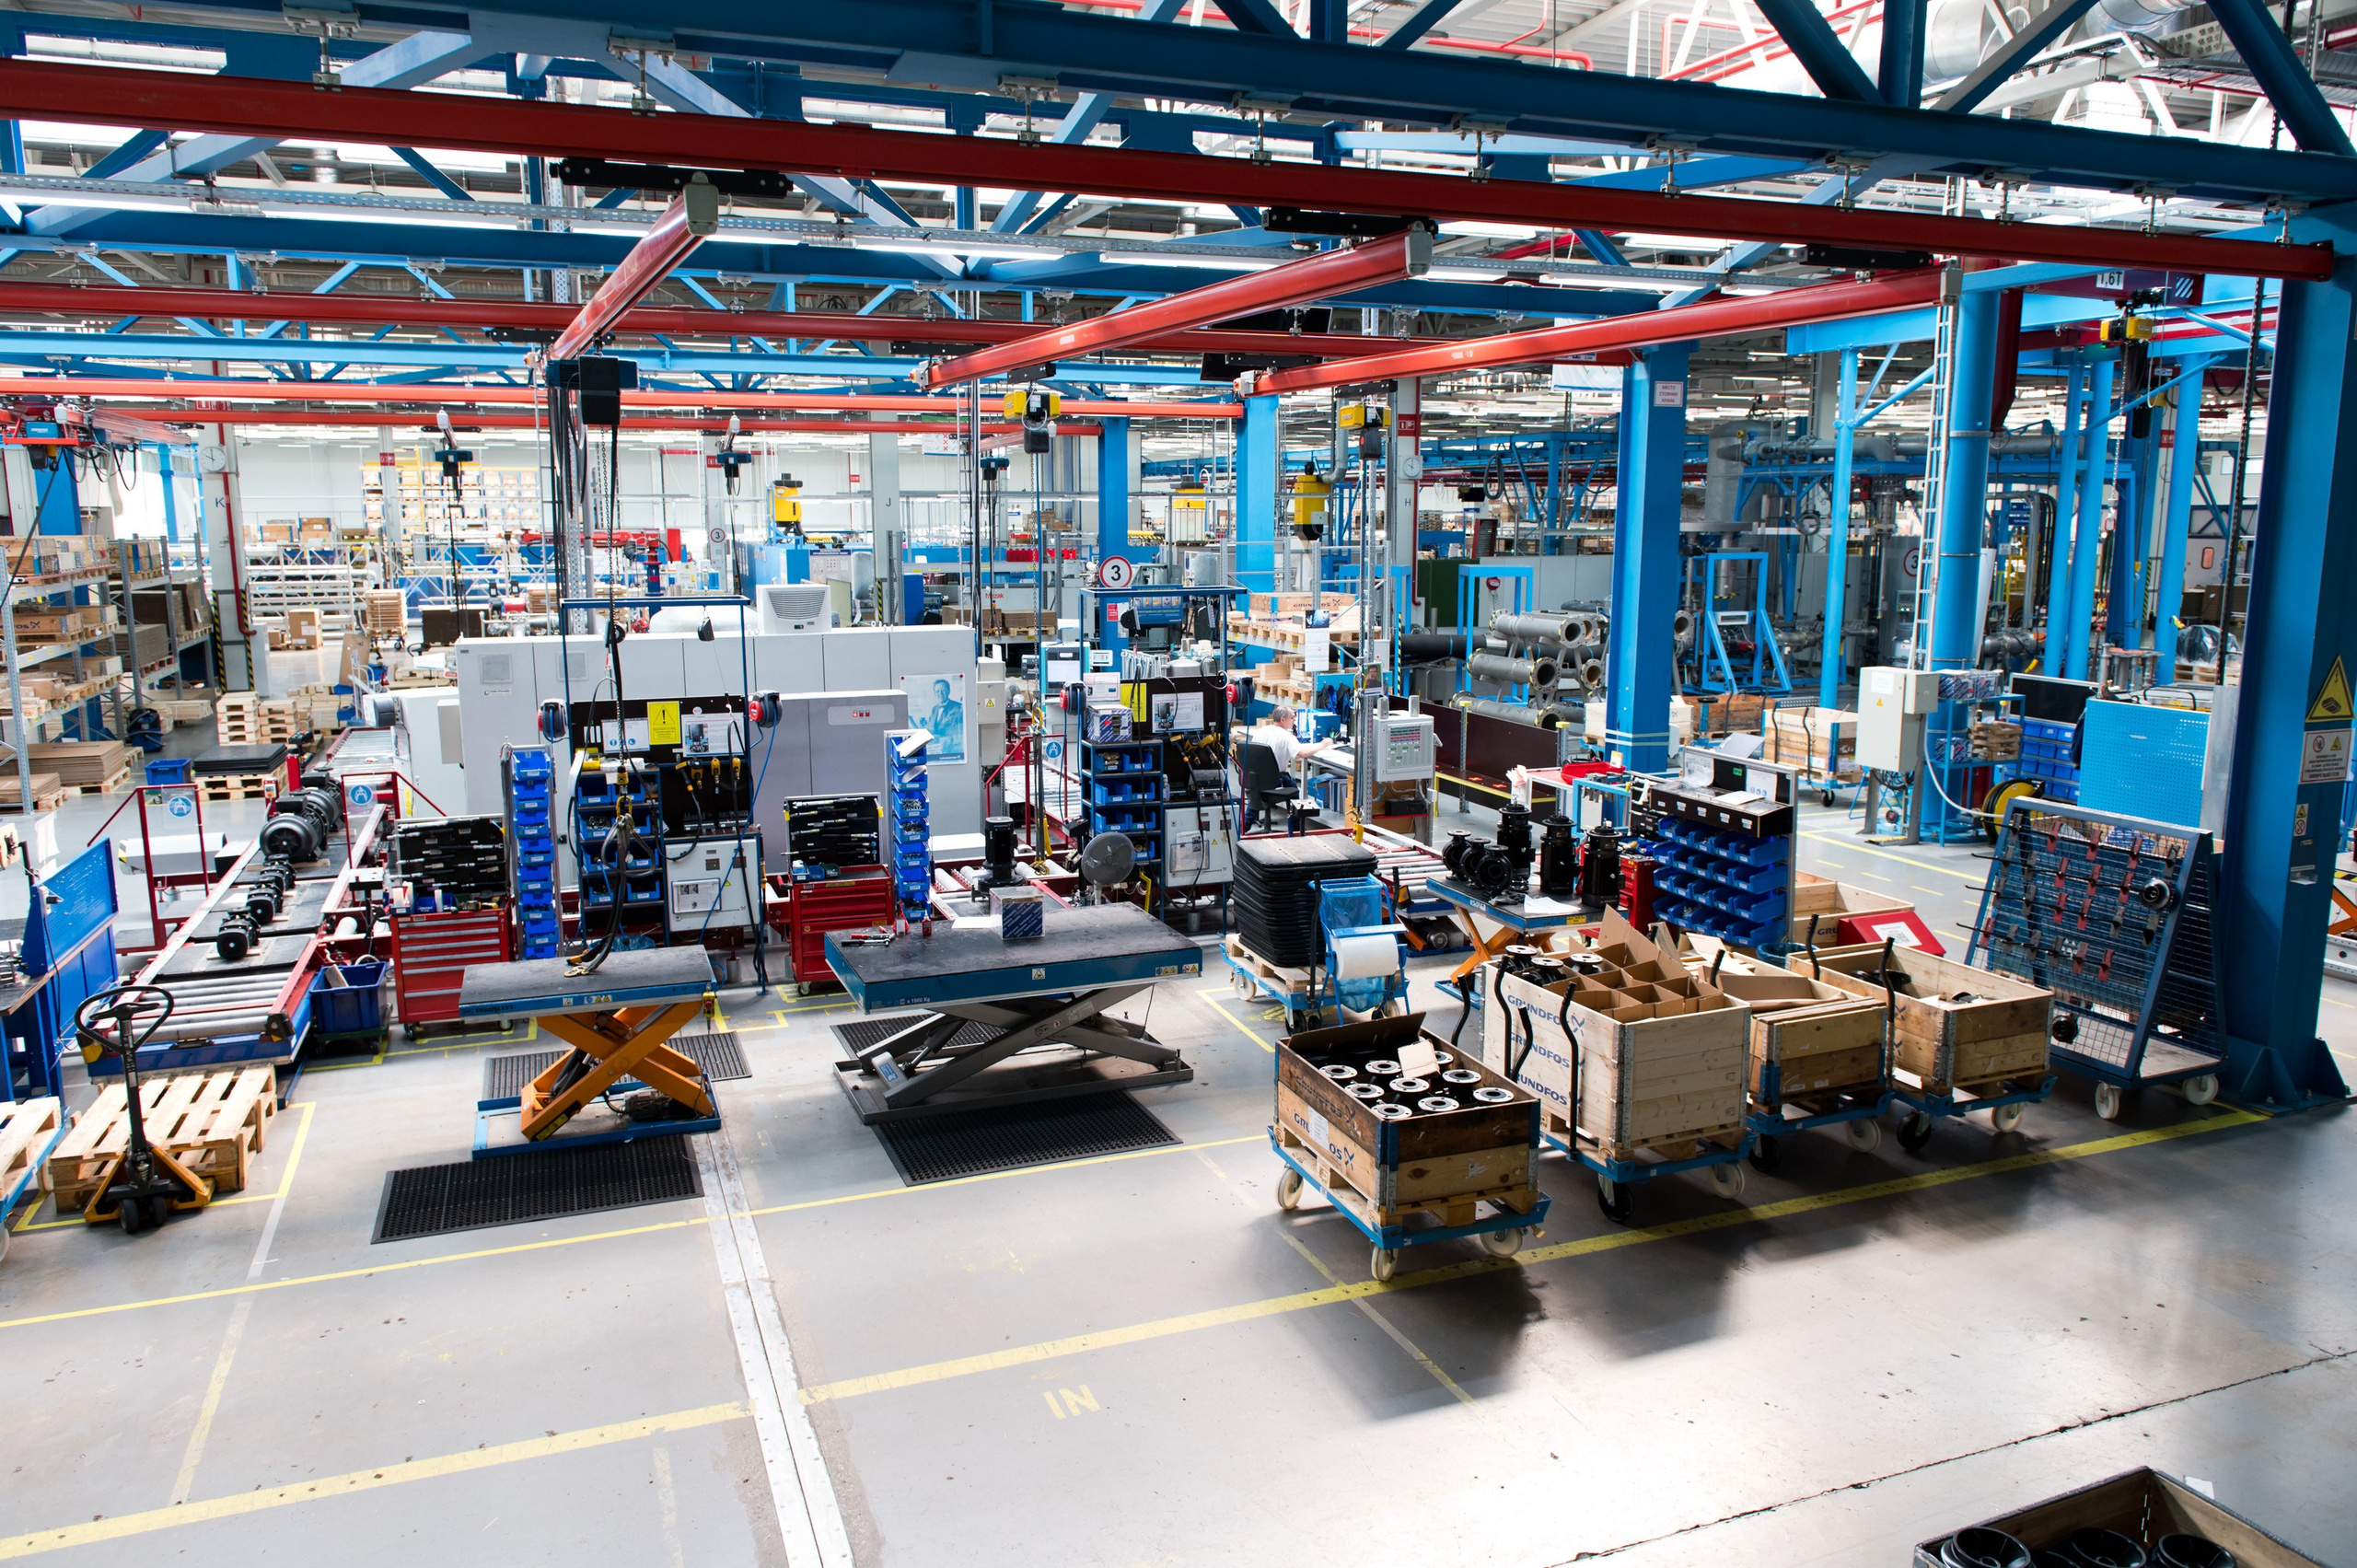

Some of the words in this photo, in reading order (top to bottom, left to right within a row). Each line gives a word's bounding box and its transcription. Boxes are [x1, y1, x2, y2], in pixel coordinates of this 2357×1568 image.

[714, 531, 721, 540] 3
[1110, 564, 1121, 582] 3
[1910, 554, 1918, 570] 3
[1507, 994, 1570, 1026] GRUNDFO
[1516, 1072, 1568, 1106] RUNDFOS
[1042, 1383, 1103, 1421] IN
